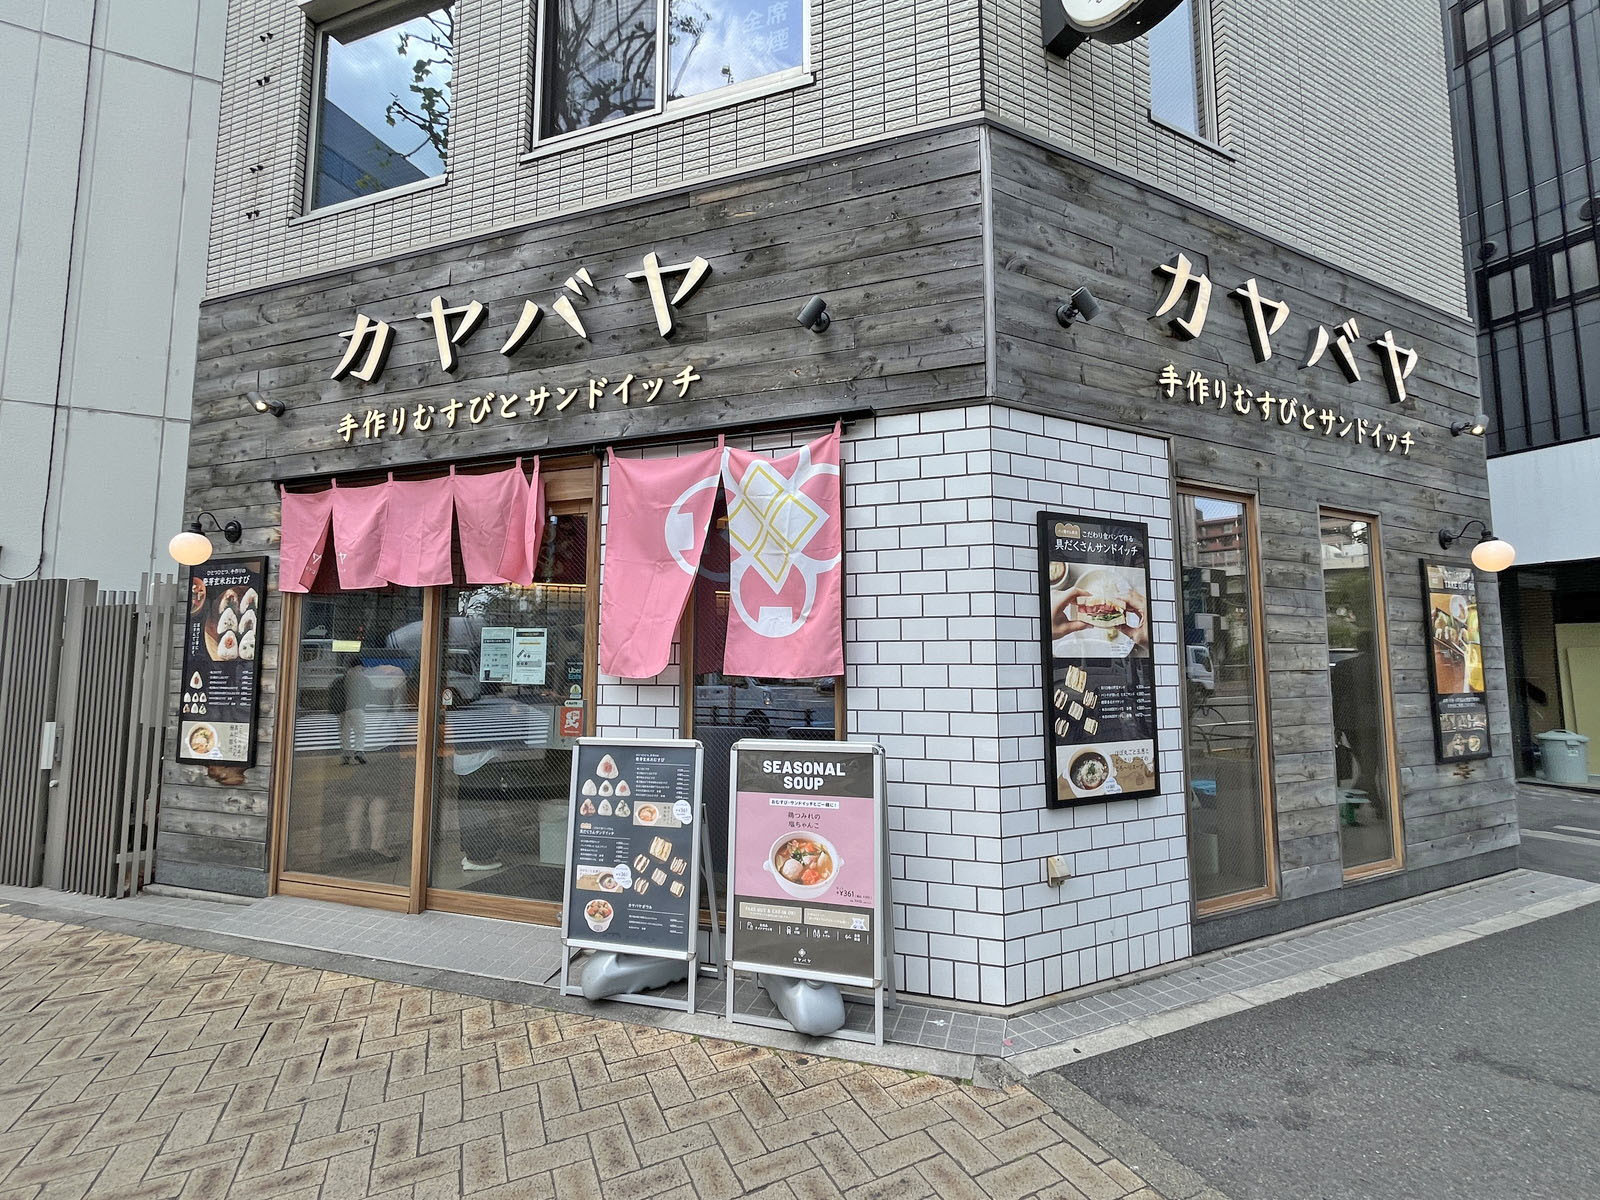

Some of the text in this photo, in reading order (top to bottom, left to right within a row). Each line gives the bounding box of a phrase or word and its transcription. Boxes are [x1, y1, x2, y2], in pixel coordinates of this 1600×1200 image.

[331, 251, 711, 385] カヤバヤ
[1153, 252, 1419, 403] カヤバヤ
[337, 364, 701, 443] 手作りむすびとサンドイッチ
[1158, 364, 1416, 456] 手作りむすびとサンドイッチ
[1081, 530, 1134, 543] こだわり食パンで作る
[1055, 538, 1139, 556] 具だくさんサンドイッチ
[762, 760, 846, 777] SEASONAL
[783, 776, 824, 791] SOUP
[788, 811, 821, 821] 鶏つみれの
[788, 821, 820, 829] 塩ちゃんこ
